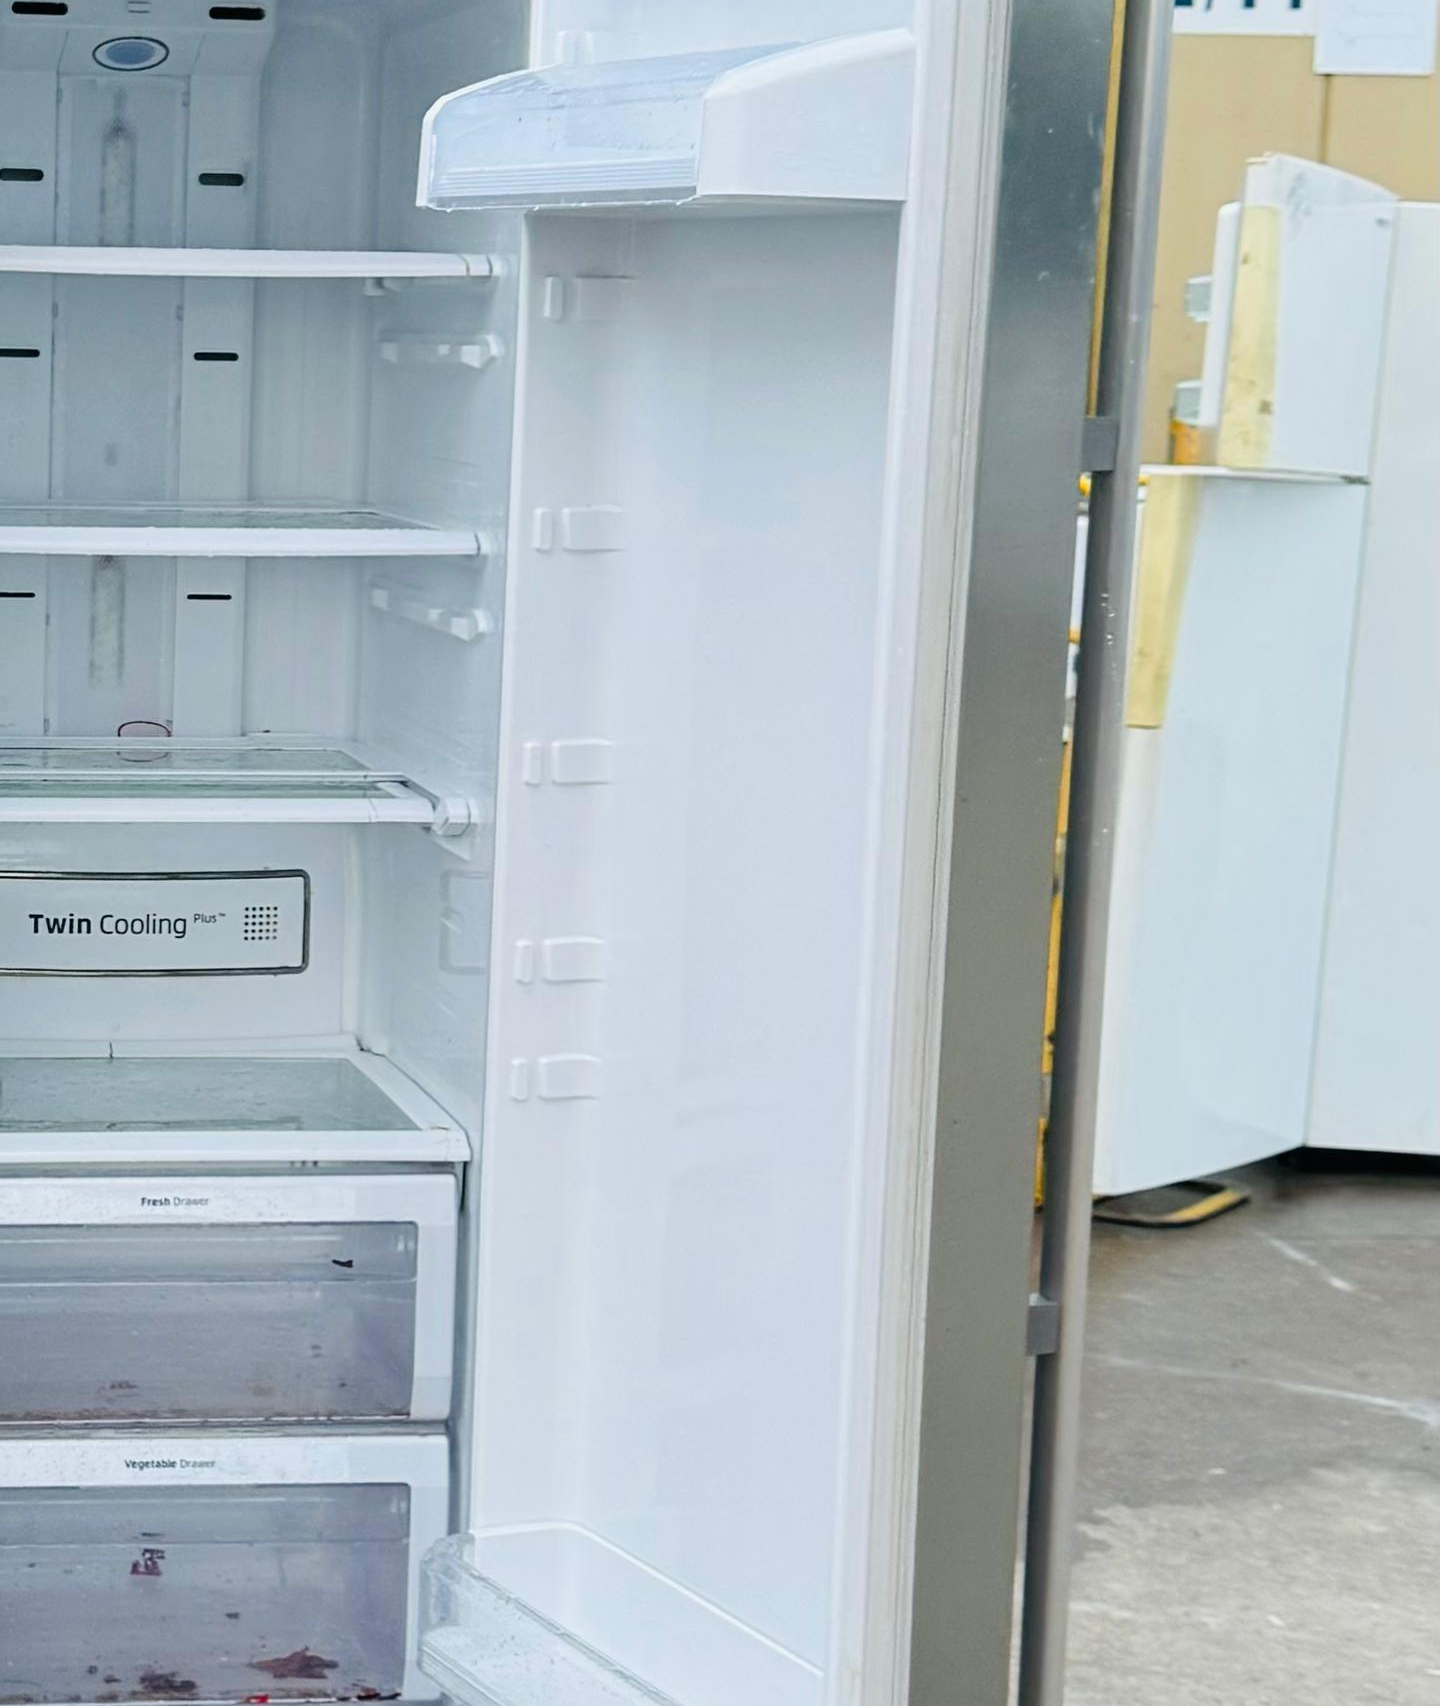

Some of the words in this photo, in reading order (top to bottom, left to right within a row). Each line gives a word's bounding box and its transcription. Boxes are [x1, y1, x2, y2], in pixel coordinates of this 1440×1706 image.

[28, 913, 92, 934] Twin
[99, 913, 187, 939] Cooling
[140, 1196, 171, 1206] Fresh
[124, 1459, 177, 1471] Vegetable
